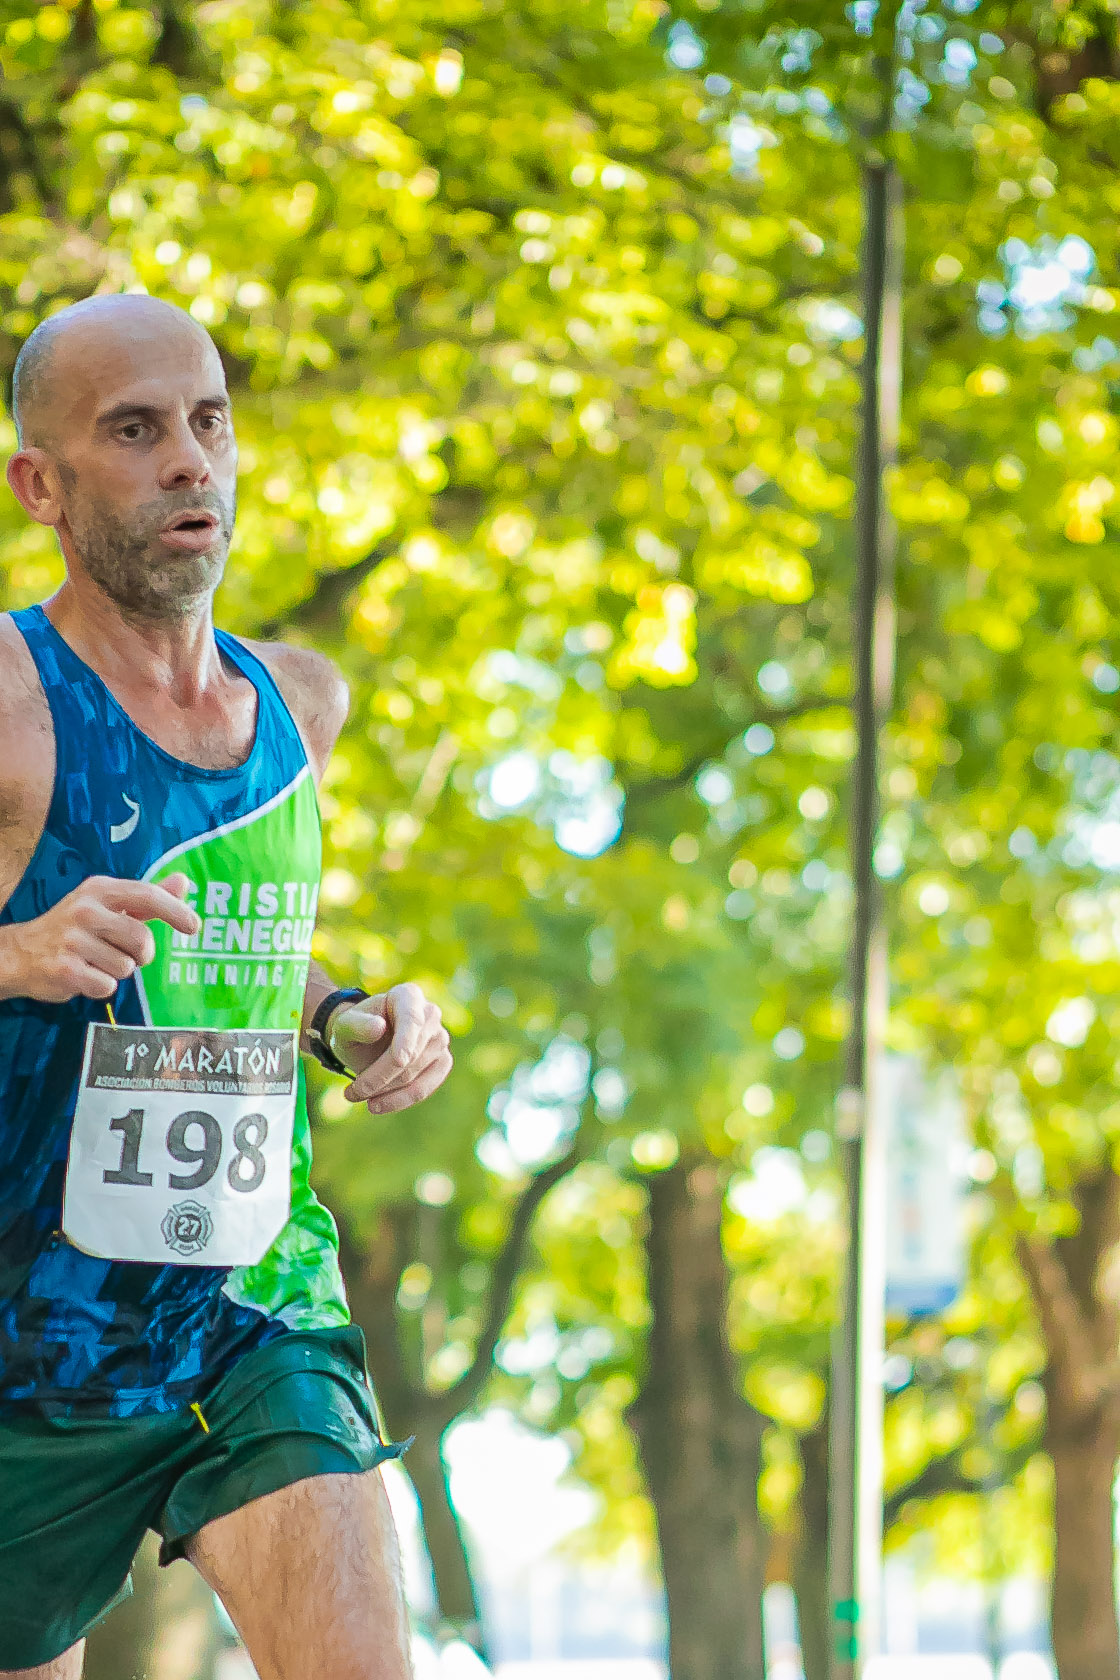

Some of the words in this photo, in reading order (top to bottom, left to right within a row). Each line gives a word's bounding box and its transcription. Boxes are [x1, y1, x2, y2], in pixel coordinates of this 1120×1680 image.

[168, 961, 284, 986] RUNNING
[154, 1038, 281, 1075] MARATÓN
[102, 1108, 269, 1193] 198
[178, 1216, 200, 1236] 27
